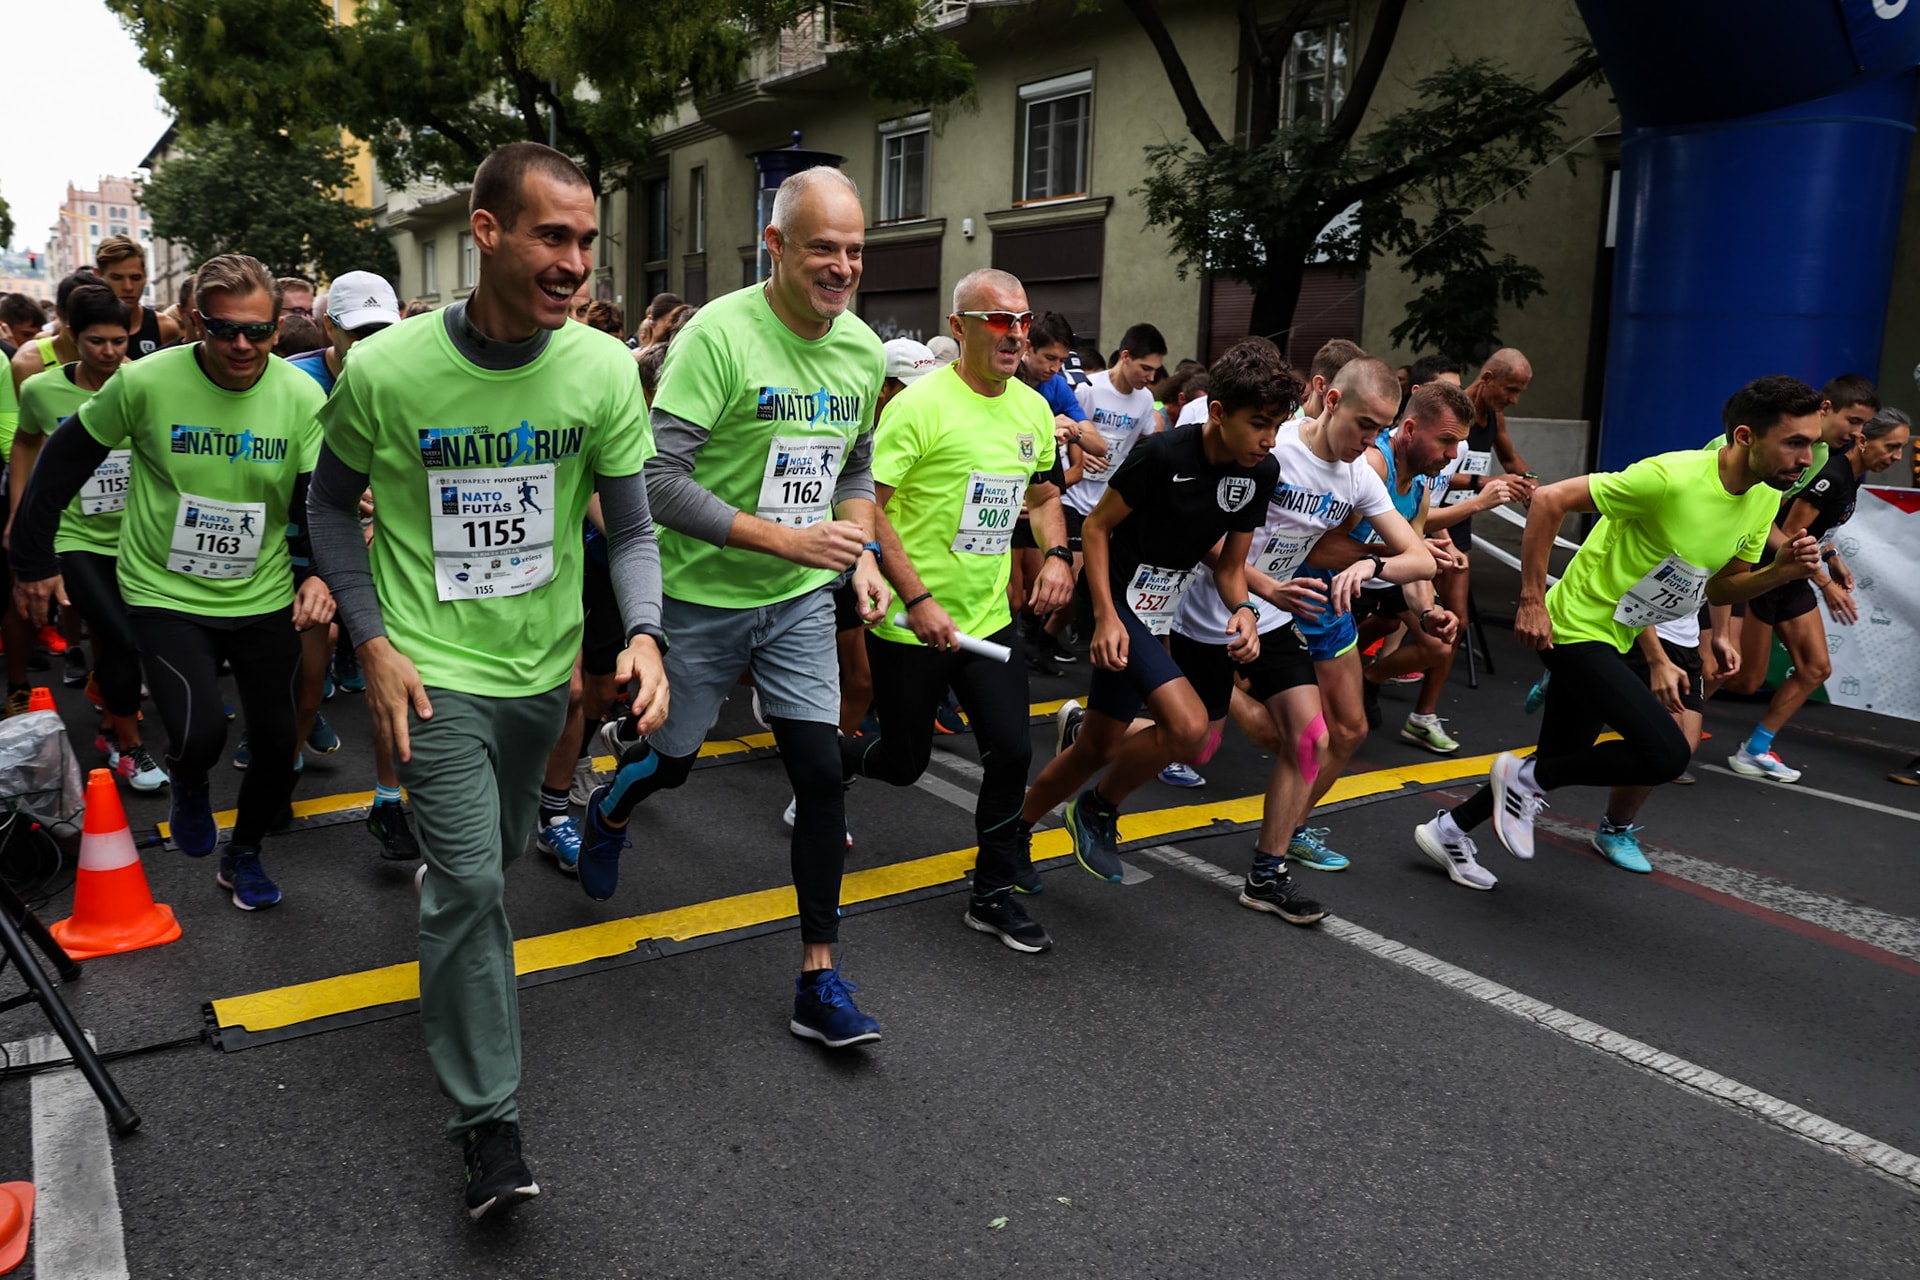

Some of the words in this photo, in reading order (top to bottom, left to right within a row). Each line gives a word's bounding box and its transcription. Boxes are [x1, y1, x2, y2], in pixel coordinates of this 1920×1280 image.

[774, 394, 815, 421] NATO
[830, 396, 860, 422] RUN
[1100, 412, 1122, 427] NATO
[472, 426, 488, 434] 2022
[186, 432, 237, 456] NATO
[252, 437, 288, 460] RUN
[442, 432, 512, 467] NATO
[534, 426, 584, 460] RUN
[790, 457, 812, 466] NATO
[462, 492, 502, 502] NATO
[782, 481, 822, 504] 1162
[985, 488, 1006, 496] NATO
[1228, 486, 1242, 502] E
[462, 500, 512, 514] FUTÁS
[1282, 490, 1319, 519] NATO
[200, 514, 230, 524] NATO
[978, 508, 1010, 528] 90/8
[462, 518, 526, 548] 1155
[196, 533, 241, 555] 1163
[1268, 556, 1294, 572] 671
[1148, 576, 1170, 585] NATO
[1670, 573, 1692, 587] NATO
[474, 585, 494, 594] 1155
[1135, 592, 1170, 611] 2521
[1650, 588, 1684, 609] 715
